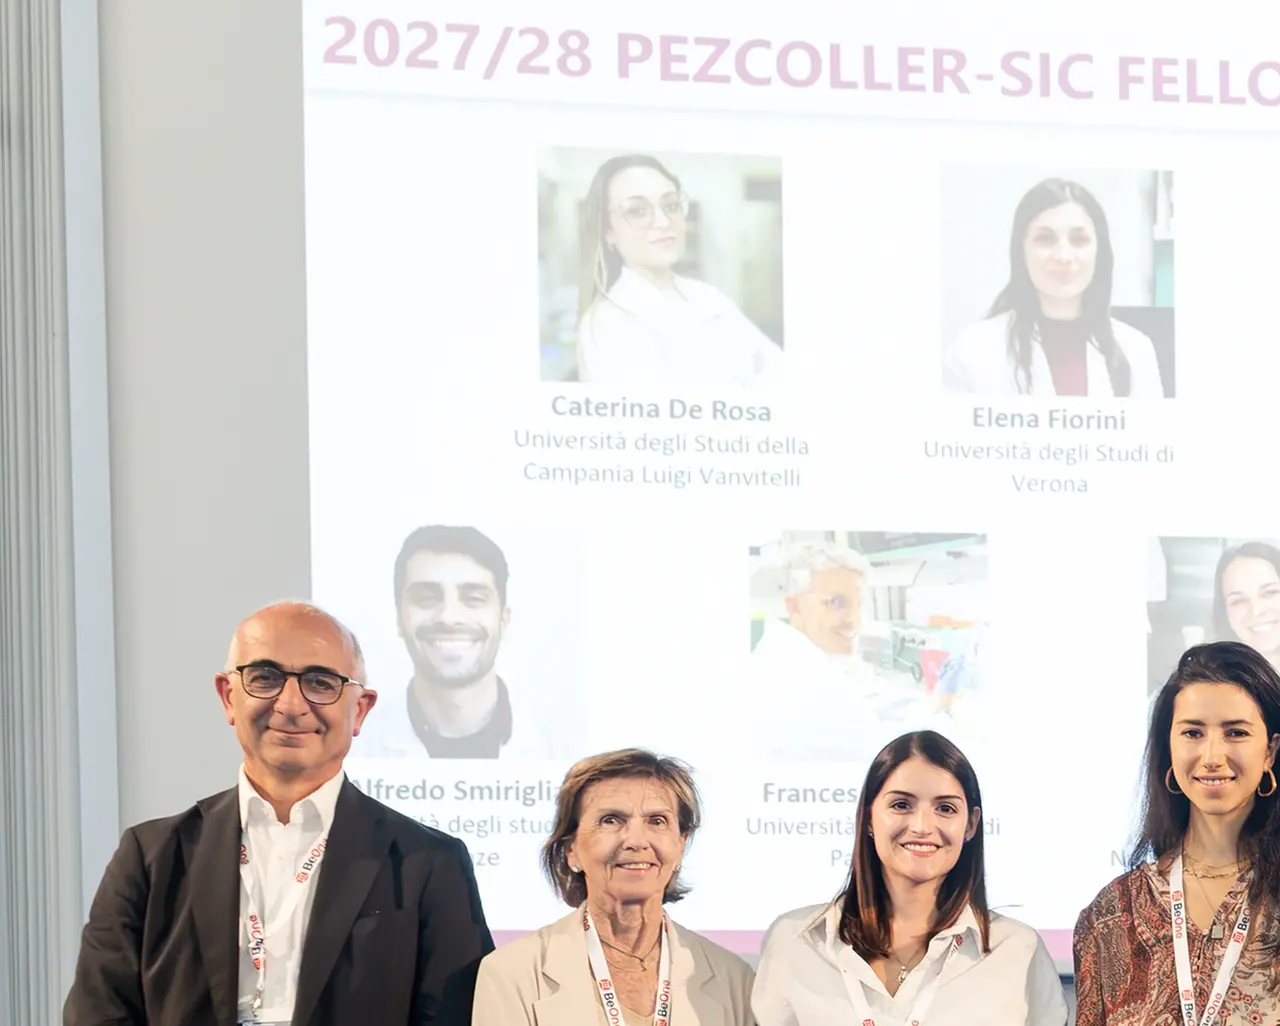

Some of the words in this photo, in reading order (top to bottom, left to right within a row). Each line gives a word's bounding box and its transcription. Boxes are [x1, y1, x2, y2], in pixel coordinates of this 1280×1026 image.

[322, 17, 592, 82] 2027/28
[616, 32, 1096, 101] PEZCOLLER-SIC
[551, 395, 660, 418] Caterina
[669, 398, 703, 420] De
[712, 400, 772, 421] Rosa
[972, 407, 1040, 429] Elena
[1048, 409, 1126, 430] Fiorini
[514, 429, 627, 451] Università
[634, 432, 687, 456] degli
[694, 433, 750, 453] Studi
[757, 435, 809, 455] della
[924, 440, 1031, 460] Università
[1039, 443, 1088, 466] degli
[1096, 444, 1149, 462] Studi
[1156, 445, 1174, 462] di
[523, 462, 634, 486] Campania
[642, 465, 691, 489] Luigi
[699, 467, 800, 487] Vanvitelli
[1011, 474, 1088, 493] Verona
[763, 782, 859, 803] Frances
[448, 816, 501, 838] degli
[509, 817, 554, 834] stu
[746, 815, 856, 835] Università
[1173, 902, 1184, 939] BeOne
[1236, 907, 1251, 932] BeO
